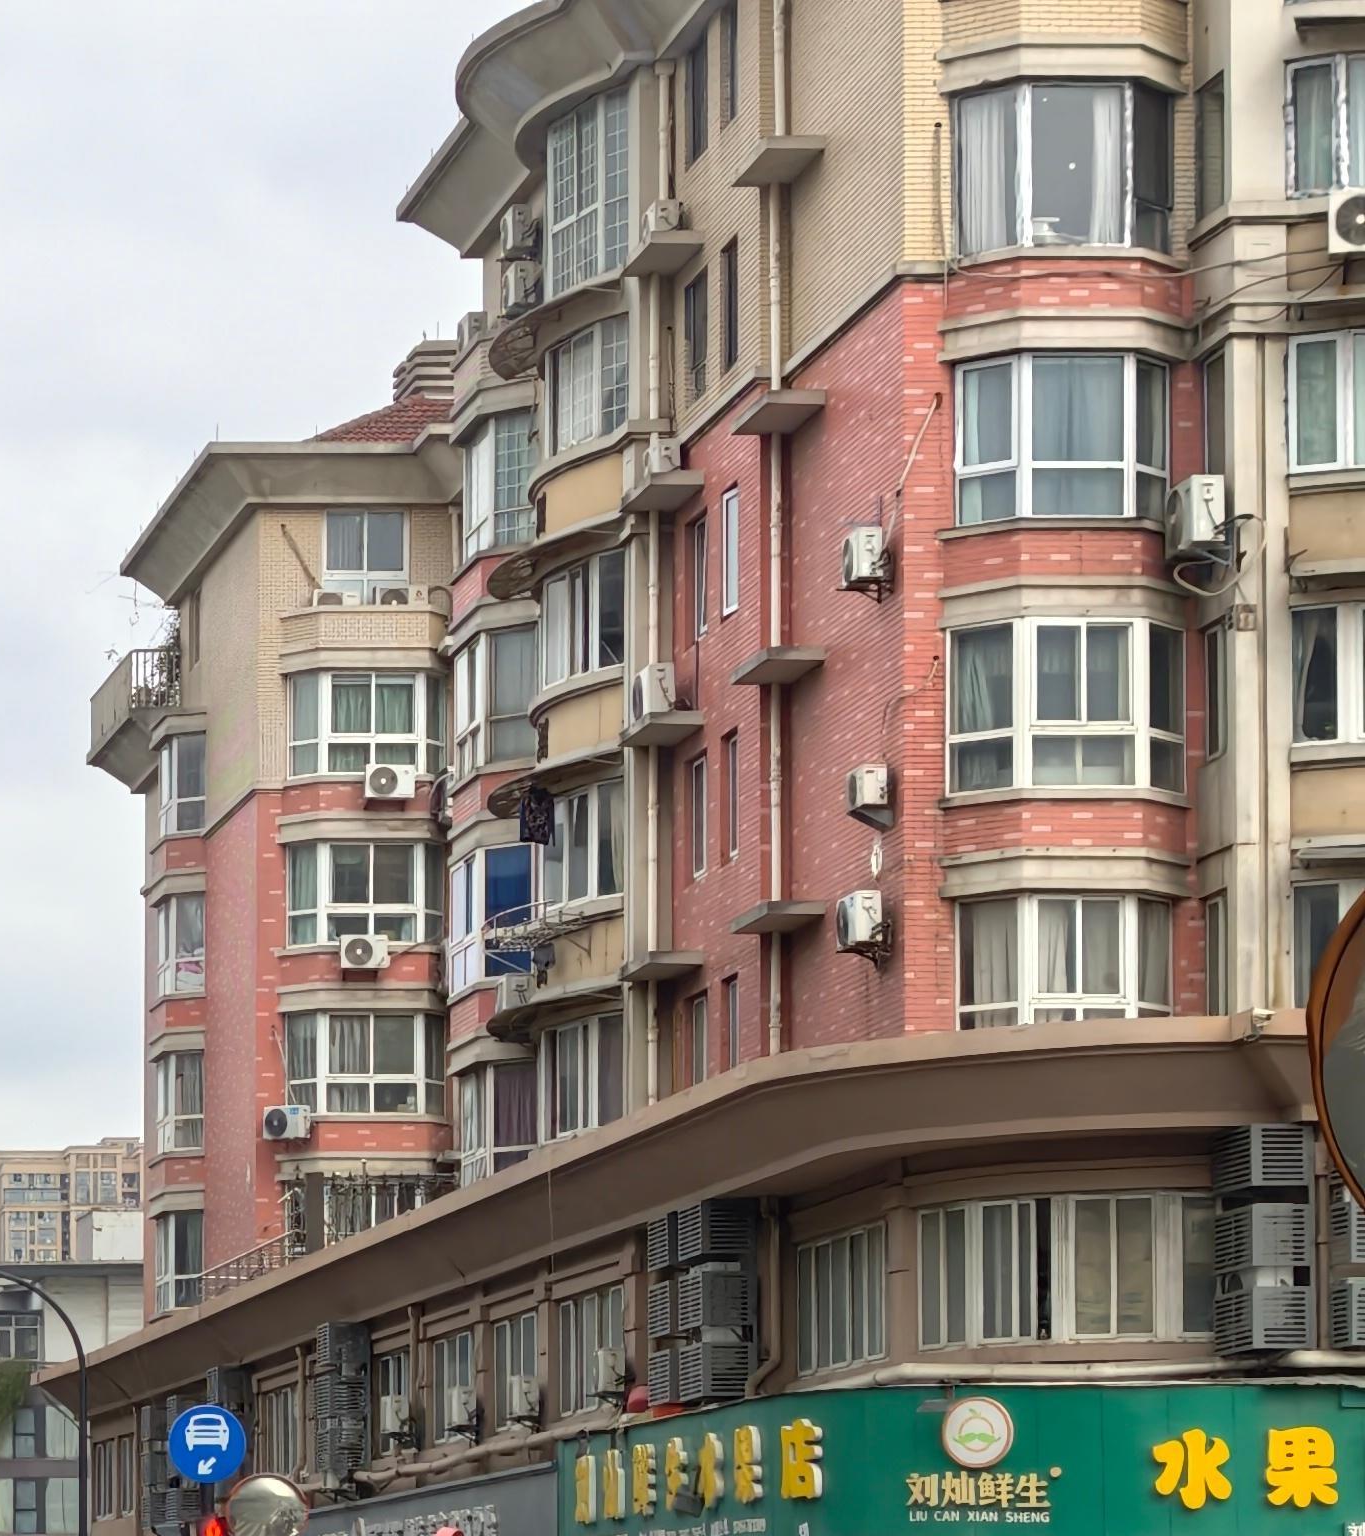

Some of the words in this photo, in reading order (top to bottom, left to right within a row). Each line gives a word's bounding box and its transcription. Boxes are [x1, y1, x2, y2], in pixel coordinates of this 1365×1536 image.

[1152, 1426, 1339, 1510] 水果
[905, 1470, 1052, 1508] 刘灿鲜生
[909, 1510, 928, 1522] LIU
[933, 1510, 960, 1522] CAN
[967, 1511, 999, 1523] XIAN
[1005, 1511, 1051, 1523] SHENG
